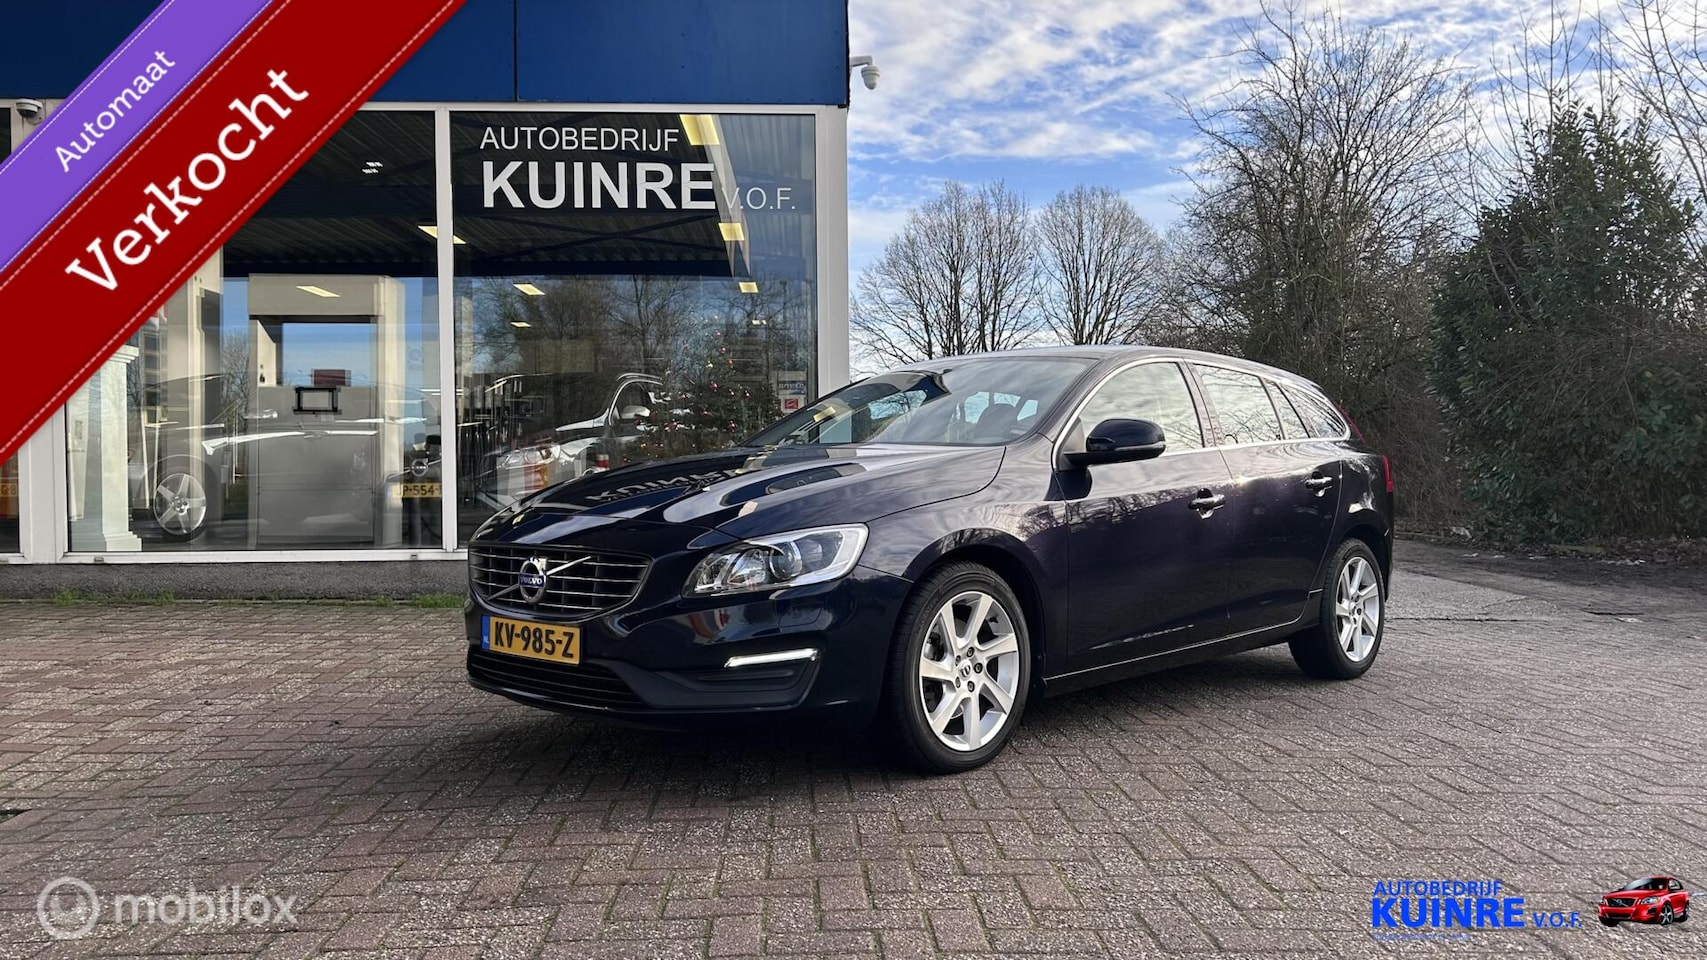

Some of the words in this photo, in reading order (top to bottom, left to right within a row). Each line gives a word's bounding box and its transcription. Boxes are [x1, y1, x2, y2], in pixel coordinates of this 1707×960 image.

[480, 127, 680, 151] AUTOBEDRIJF
[482, 160, 716, 210] KUINRE
[721, 186, 796, 210] V.O.F.
[494, 620, 574, 659] KV-985-Z
